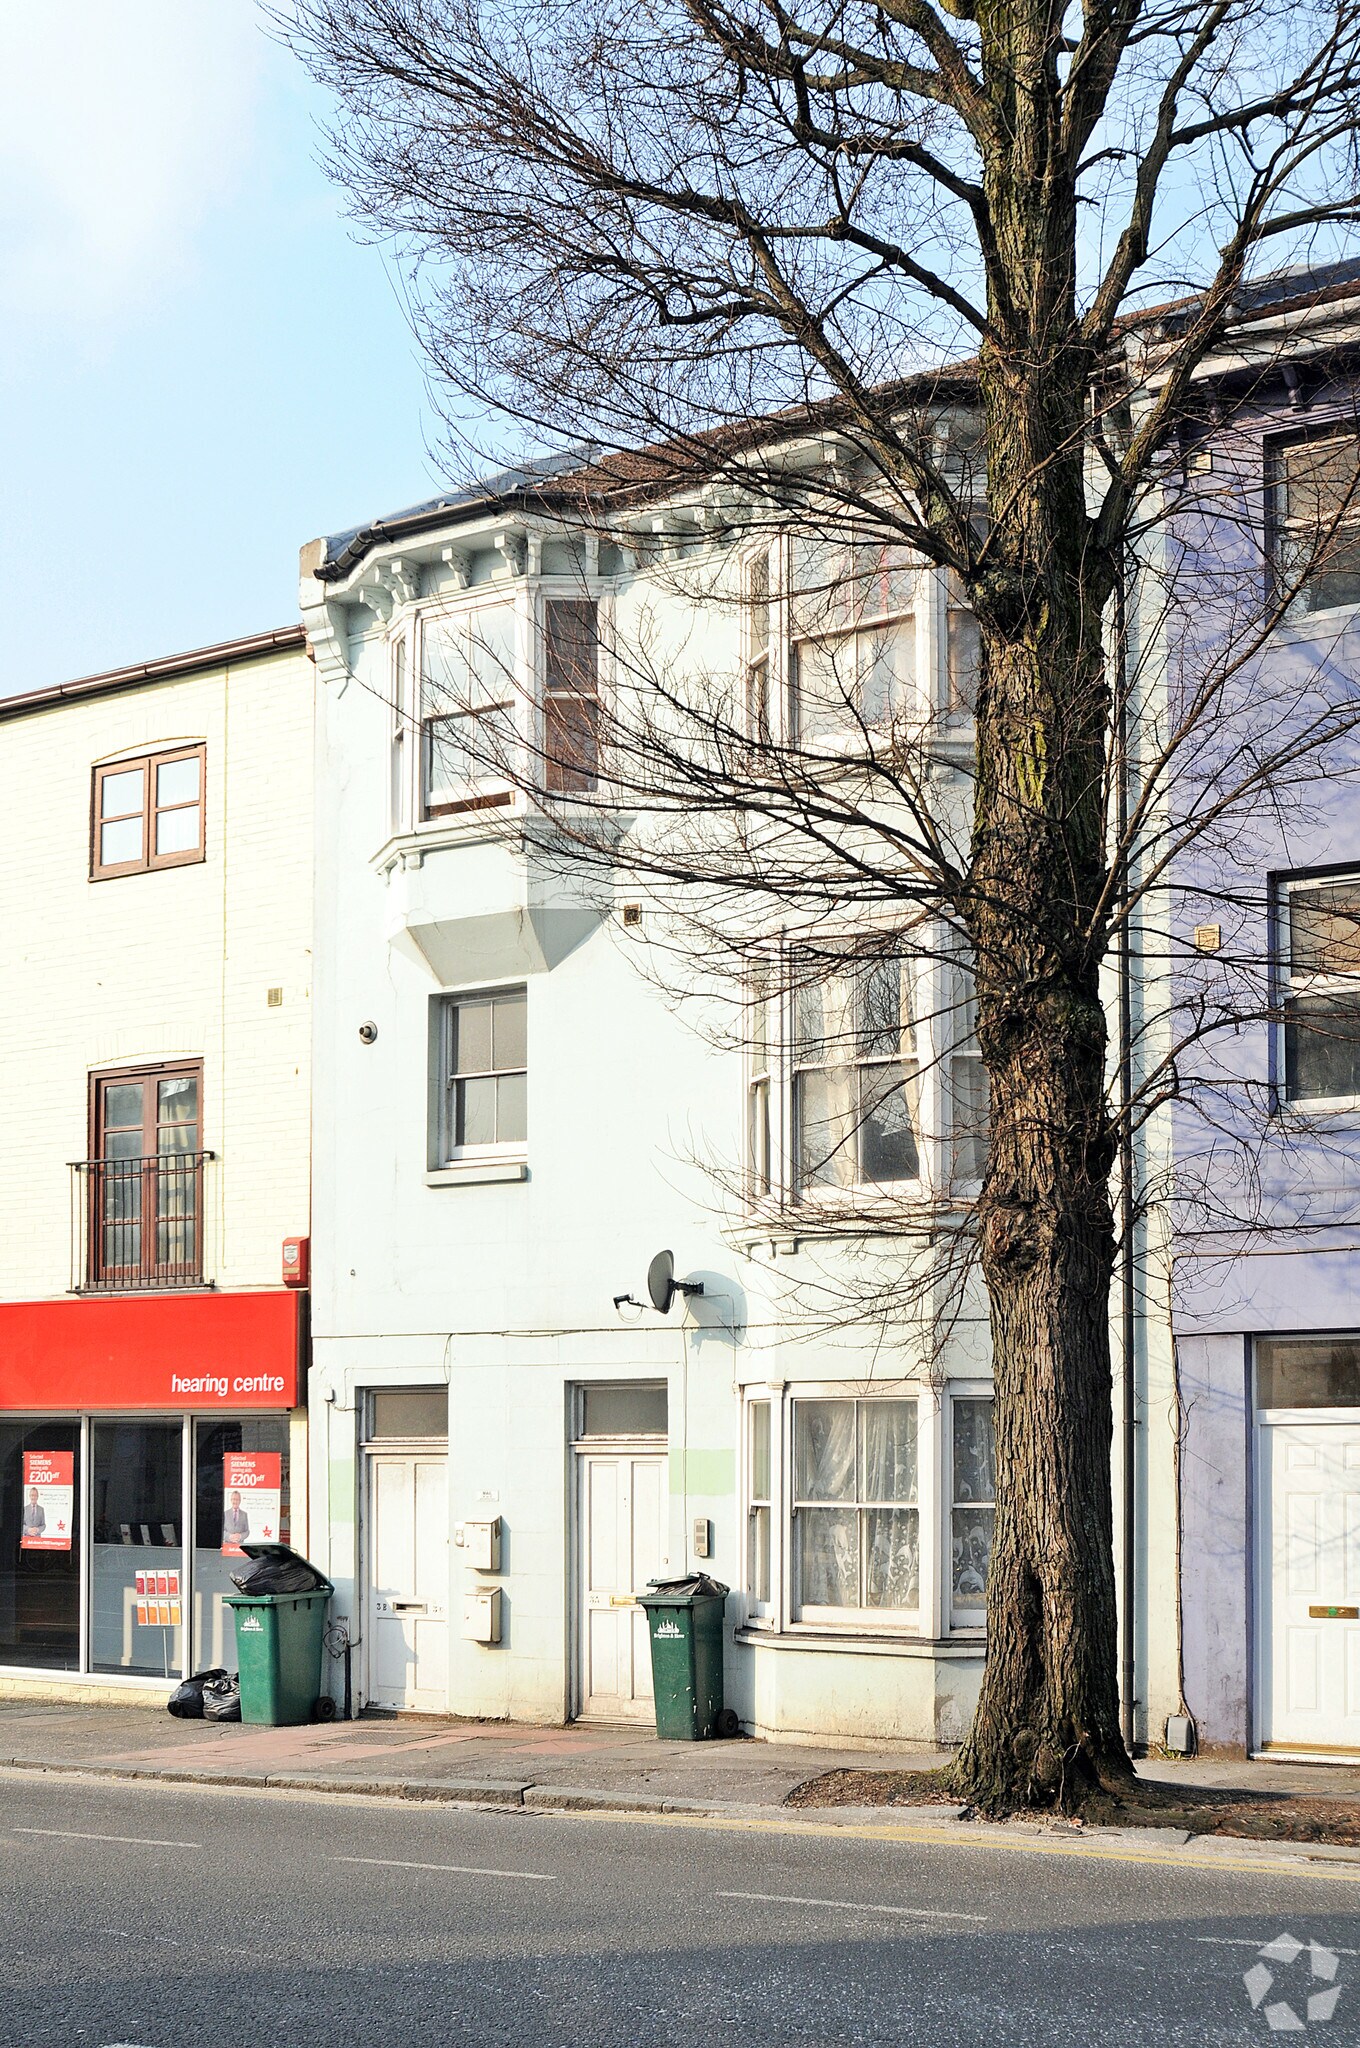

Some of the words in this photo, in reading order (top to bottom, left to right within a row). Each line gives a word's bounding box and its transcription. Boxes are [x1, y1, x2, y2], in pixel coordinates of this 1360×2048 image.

[171, 1373, 229, 1397] hearing
[233, 1373, 285, 1392] centre
[29, 1471, 53, 1483] £200
[230, 1473, 257, 1487] £200
